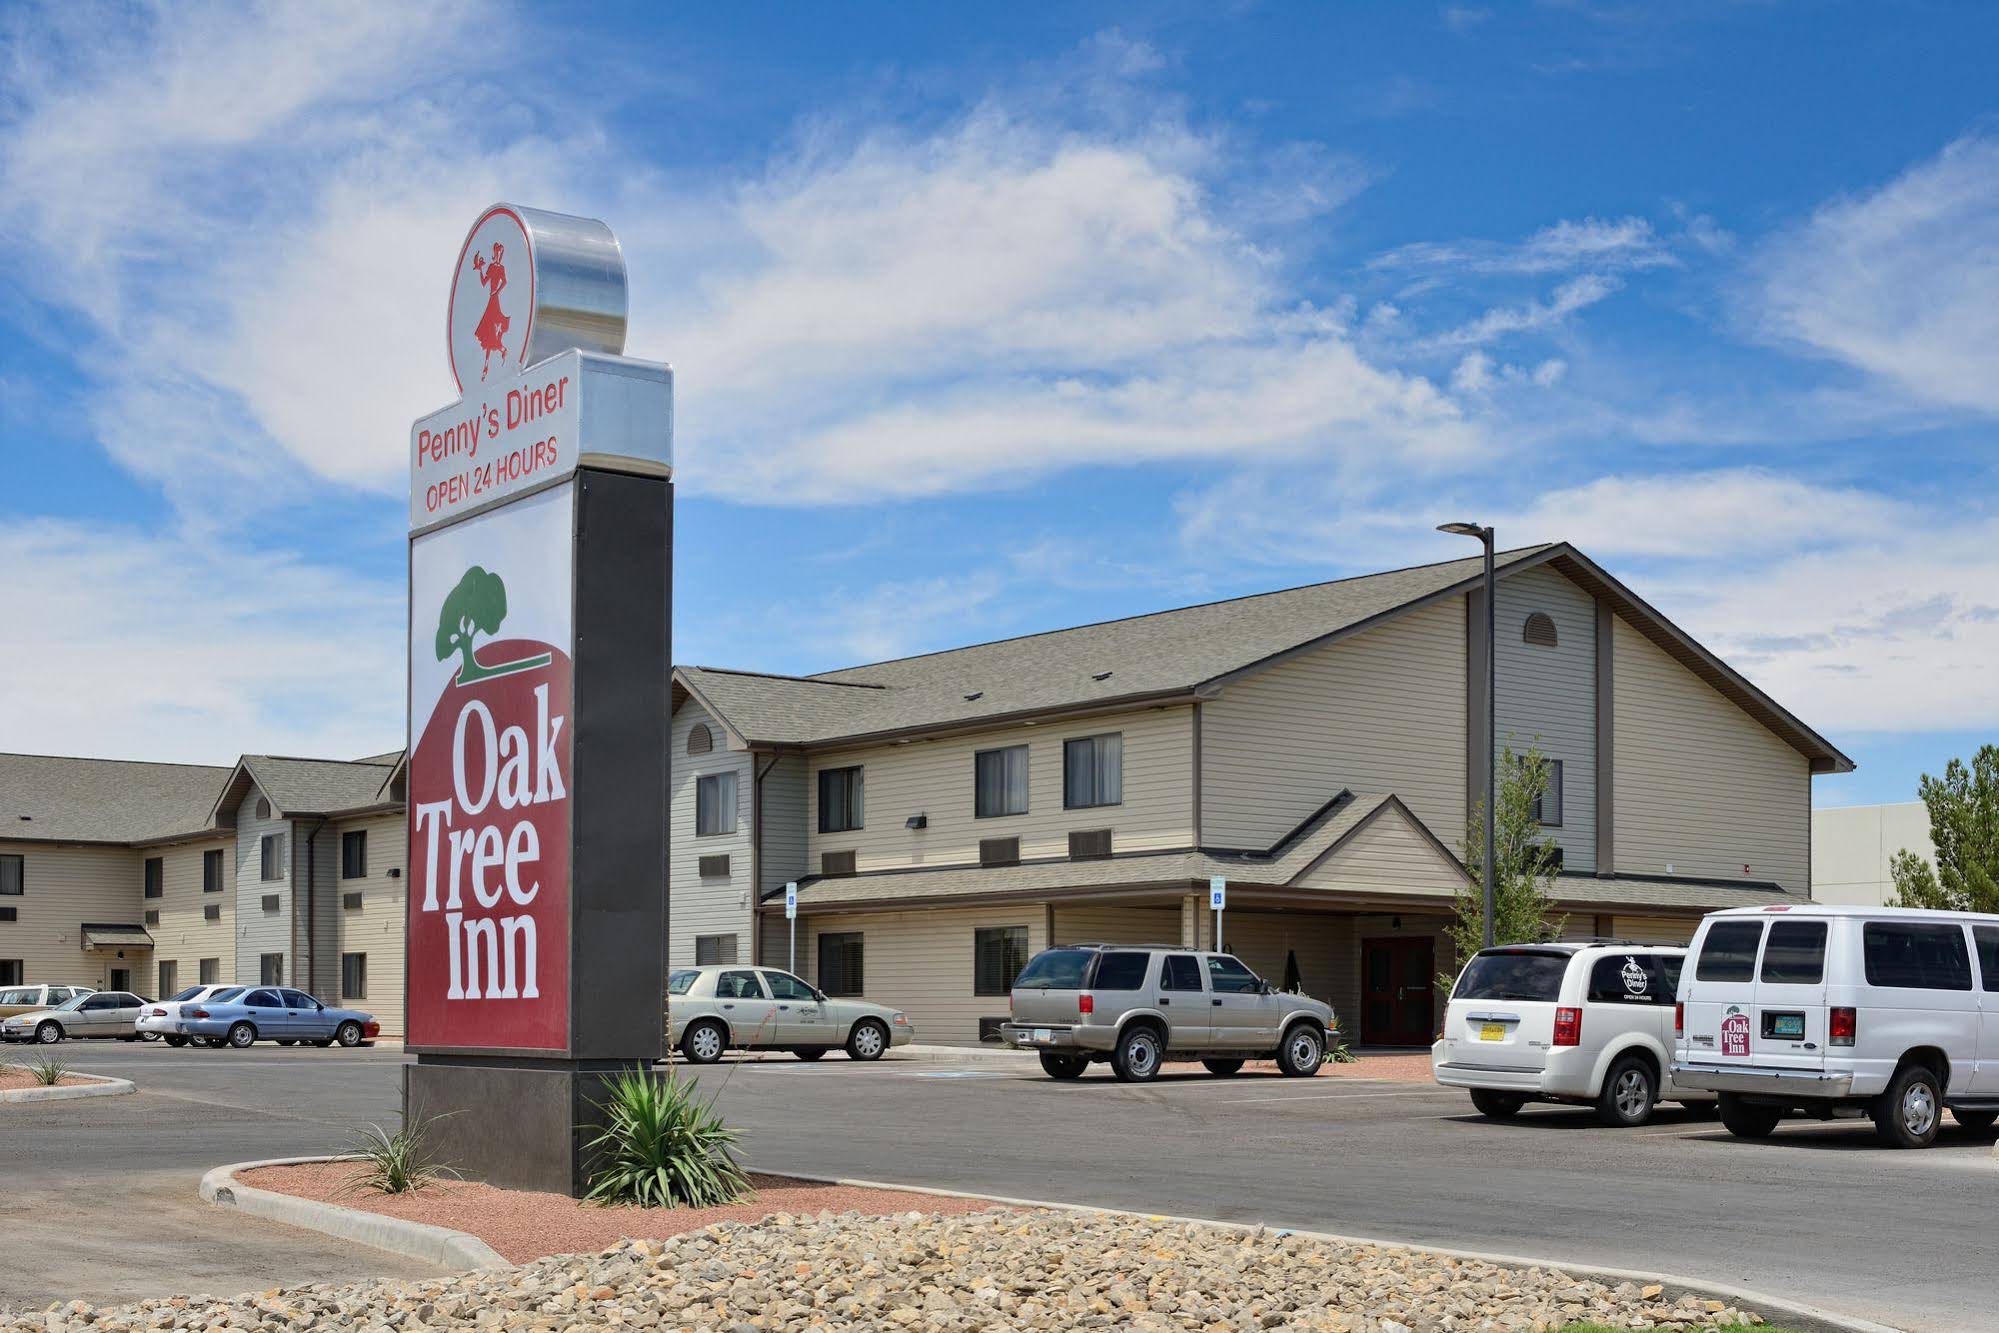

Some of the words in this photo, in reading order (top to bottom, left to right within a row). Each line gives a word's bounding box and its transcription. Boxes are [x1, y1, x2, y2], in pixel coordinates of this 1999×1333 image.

[418, 403, 500, 467] Penny's
[507, 376, 569, 431] Diner
[426, 474, 469, 513] OPEN
[474, 462, 491, 494] 24
[497, 436, 558, 484] HOURS
[452, 683, 566, 815] Oak
[416, 798, 540, 912] Tree
[445, 911, 540, 999] Inn
[1621, 970, 1648, 982] Penny's
[1626, 979, 1645, 988] Diner
[1722, 1030, 1744, 1043] Tree
[1728, 1019, 1749, 1034] Oak
[1728, 1043, 1745, 1054] Inn
